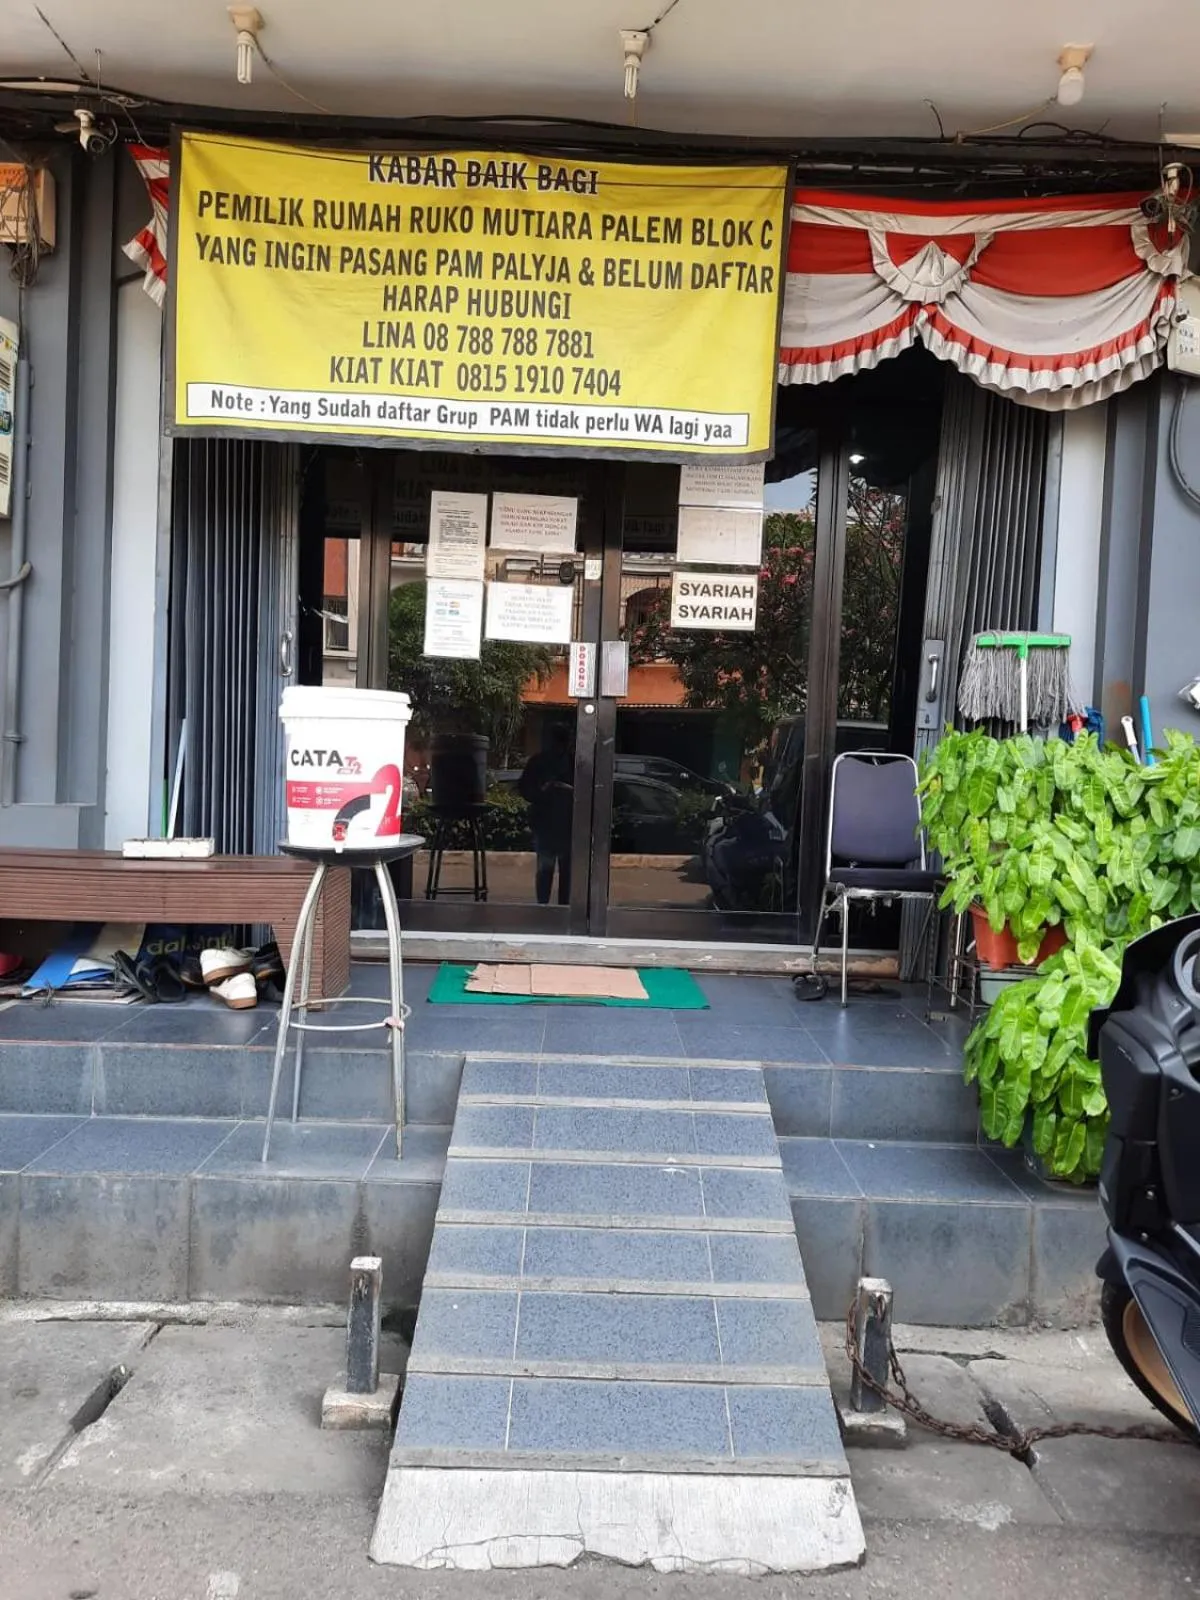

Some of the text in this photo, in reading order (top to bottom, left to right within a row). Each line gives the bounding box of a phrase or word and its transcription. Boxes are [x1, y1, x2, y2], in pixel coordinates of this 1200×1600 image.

[369, 154, 599, 194] KABAR BAIK BAGI
[198, 190, 773, 250] PEMILIK RUMAH RUKO MUTIARA PALEM BLOK C
[195, 232, 774, 293] YANG INGIN PASANG PAM PALYJA & BELUM DAFTAR
[383, 285, 571, 320] HARAP HUBUNGI
[363, 321, 594, 358] LINA 08 788 788 7881
[329, 356, 621, 396] KIAT KIAT 0815 1910 7404
[211, 389, 253, 411] Note
[317, 398, 371, 420] Sudah
[377, 401, 430, 422] daftar
[436, 404, 478, 429] Grup
[490, 407, 530, 427] PAM
[536, 409, 579, 429] tidak
[586, 411, 629, 433] perlu
[635, 413, 663, 433] WA
[669, 416, 698, 440] lagi
[703, 422, 732, 441] yaa
[679, 582, 754, 599] SYARIAH
[678, 604, 753, 621] SYARIAH
[577, 646, 586, 688] DORONG
[291, 749, 343, 766] CATA
